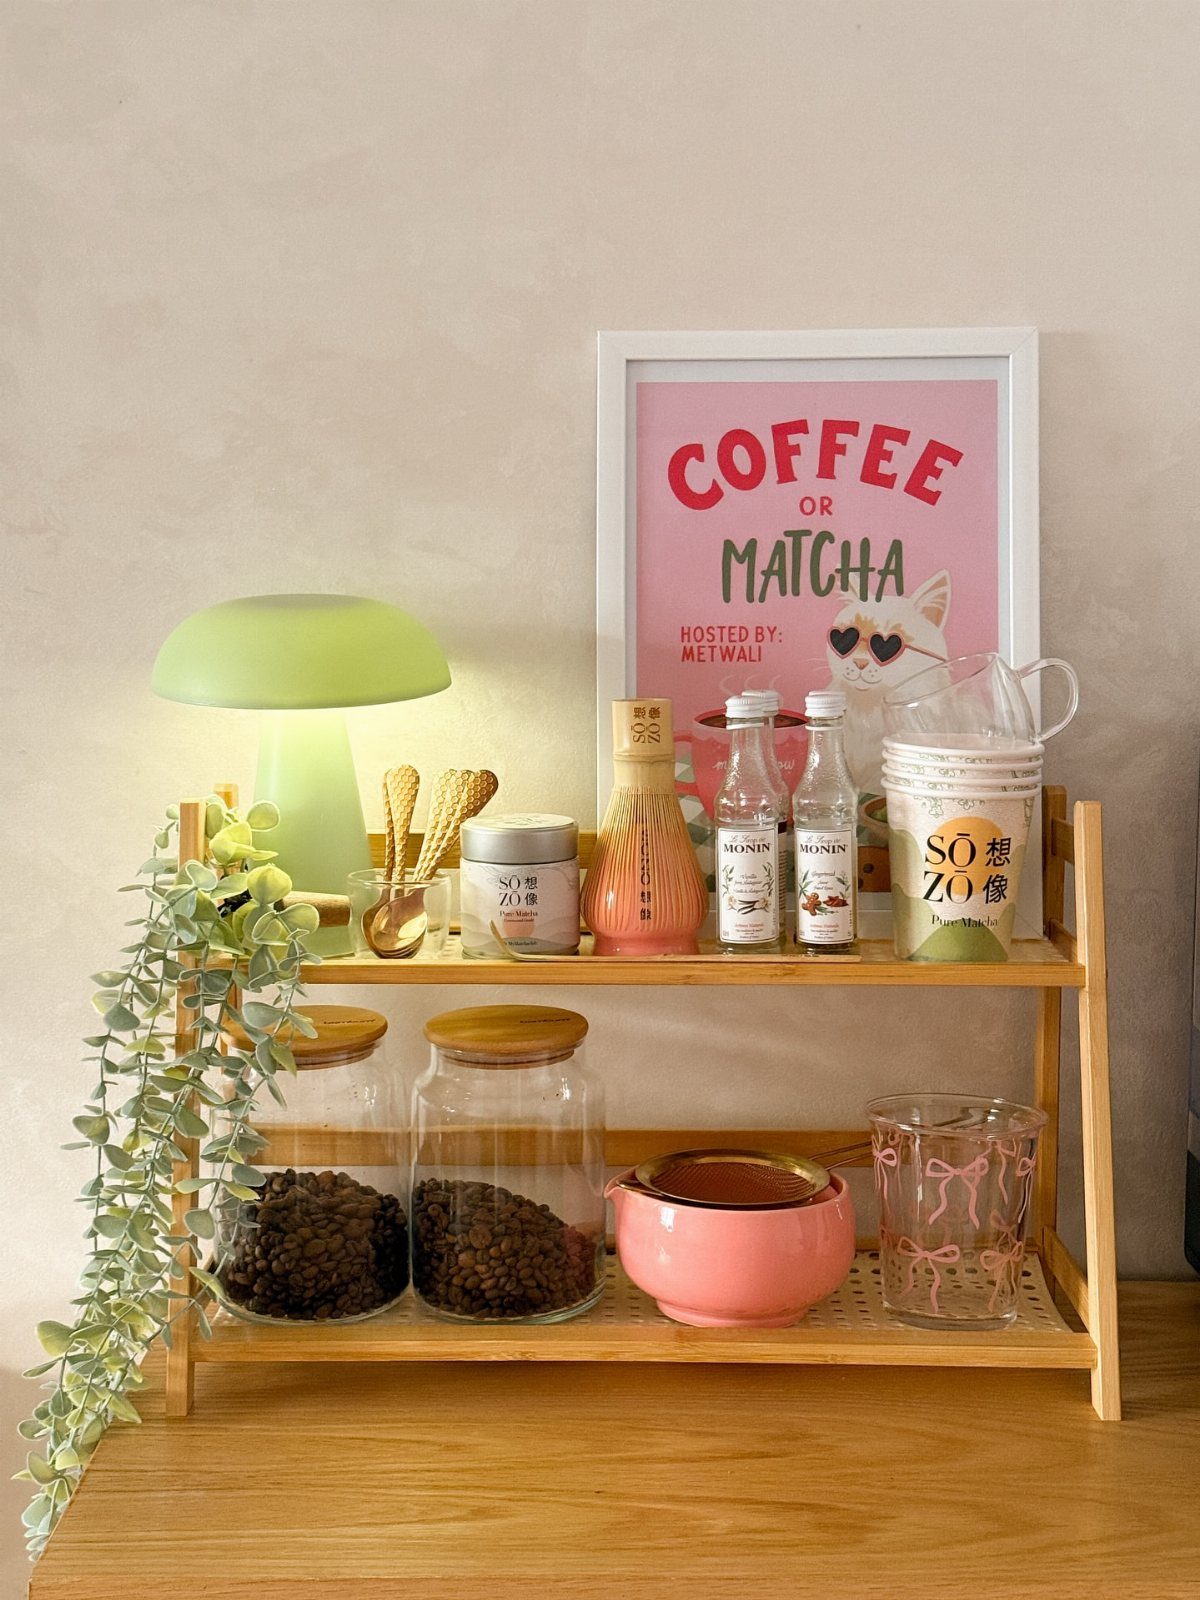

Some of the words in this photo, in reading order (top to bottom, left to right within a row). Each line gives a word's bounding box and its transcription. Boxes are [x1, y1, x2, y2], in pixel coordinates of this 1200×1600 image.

[668, 419, 964, 511] COFFEE
[799, 496, 833, 516] OR
[722, 530, 904, 603] MATCHA
[681, 626, 748, 643] HOSTED
[755, 626, 782, 643] BY:
[681, 645, 762, 662] METWALI
[724, 843, 770, 853] MONIN
[800, 844, 846, 854] MONIN
[925, 833, 976, 868] SŌ
[985, 837, 1012, 867] 想
[499, 875, 520, 890] SŌ
[922, 870, 973, 904] ZŌ
[983, 873, 1008, 904] 像
[499, 891, 520, 906] ZŌ
[516, 910, 538, 918] Matcha
[931, 914, 958, 927] Pure
[961, 916, 998, 928] Matcha
